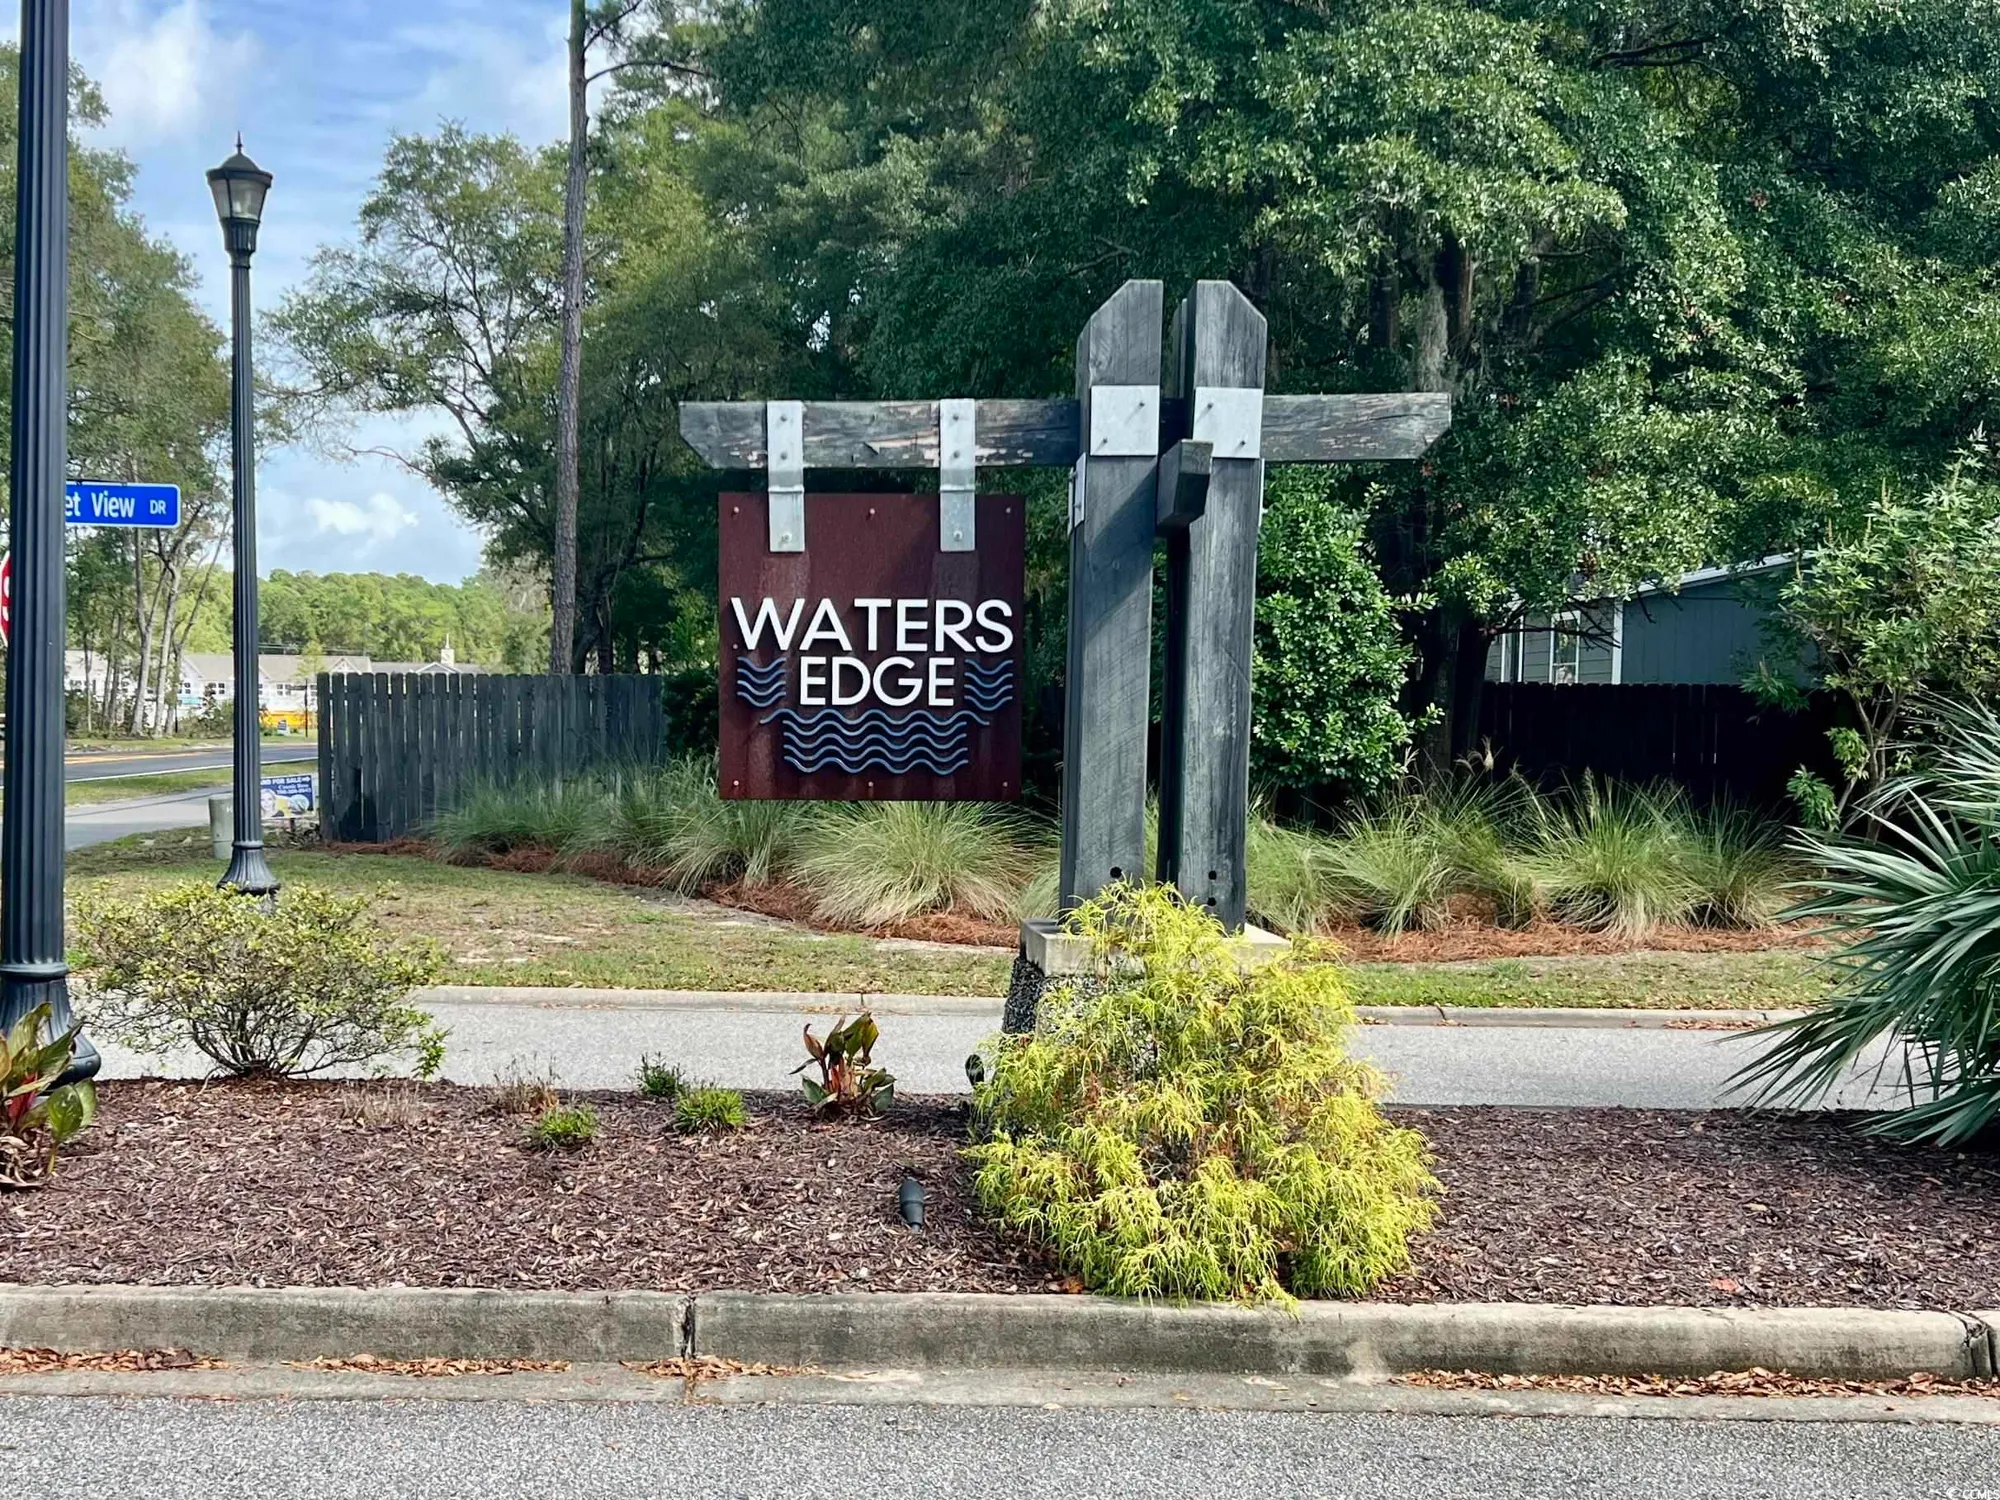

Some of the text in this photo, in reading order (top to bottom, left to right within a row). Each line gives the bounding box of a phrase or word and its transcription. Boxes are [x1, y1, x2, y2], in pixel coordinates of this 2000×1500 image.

[91, 490, 135, 518] View
[149, 500, 167, 515] DR
[729, 596, 1014, 654] WATERS
[800, 656, 955, 707] EDGE
